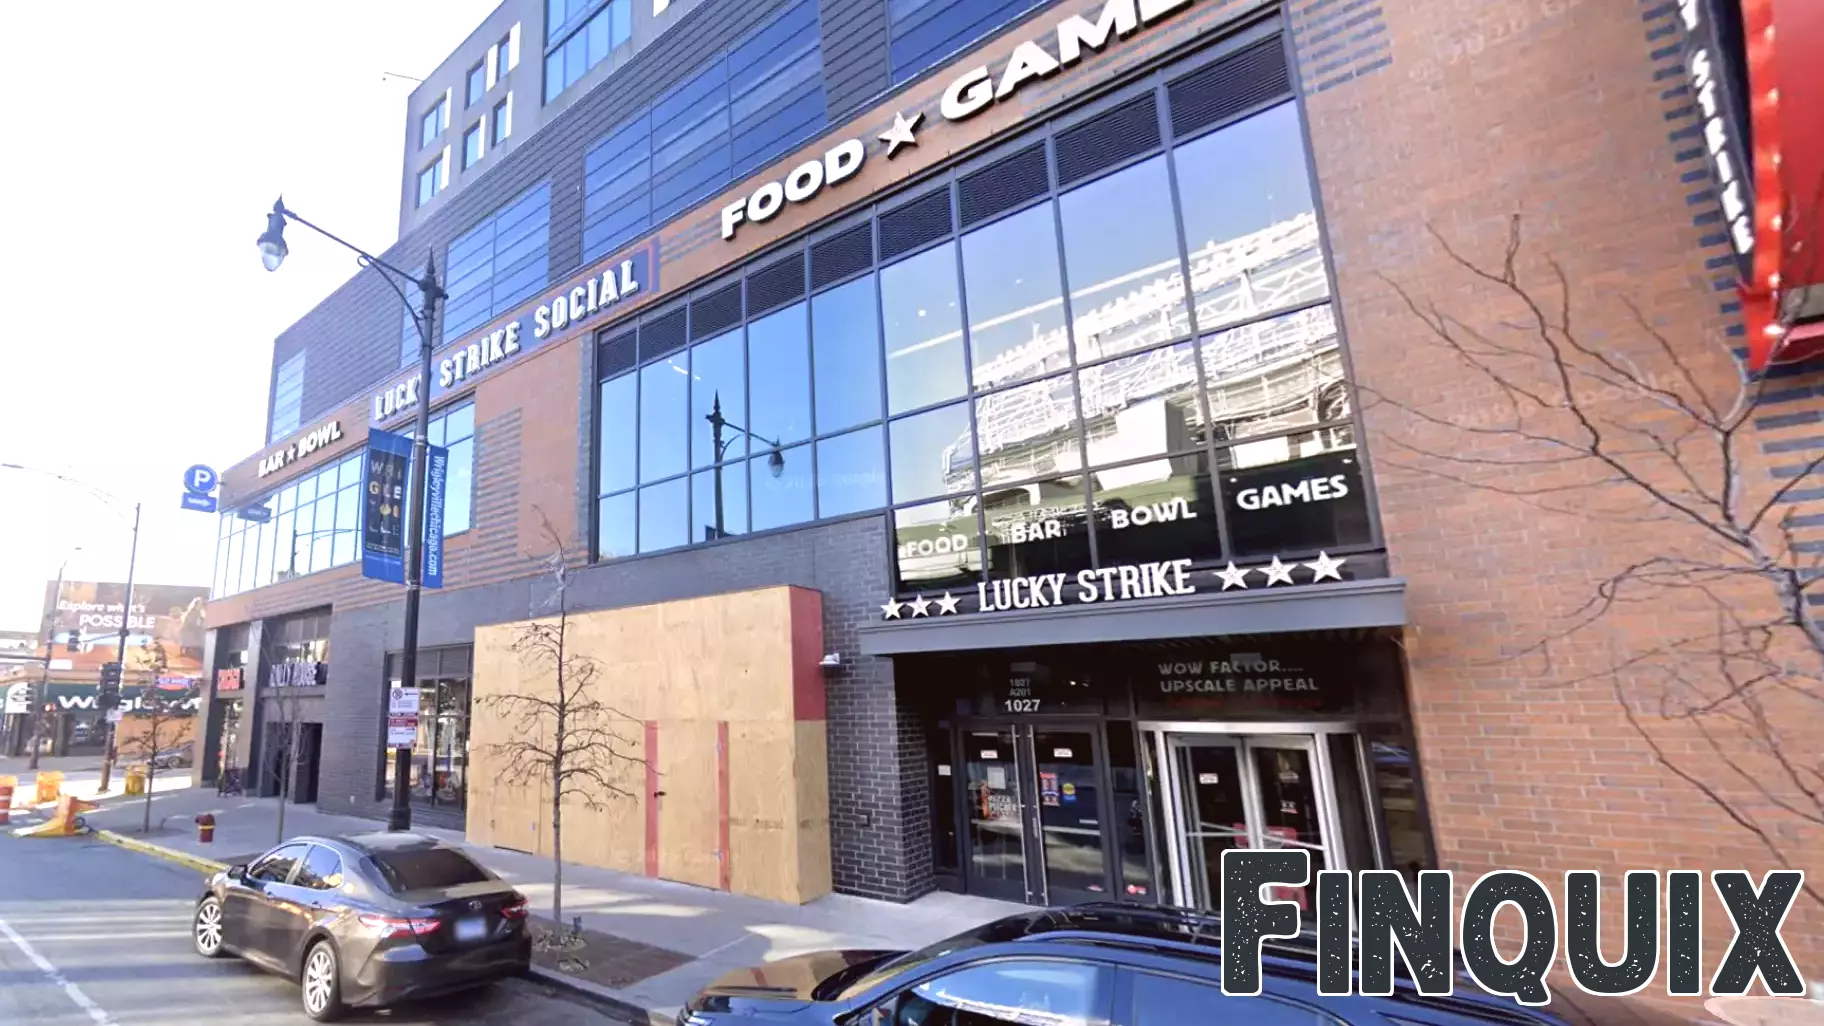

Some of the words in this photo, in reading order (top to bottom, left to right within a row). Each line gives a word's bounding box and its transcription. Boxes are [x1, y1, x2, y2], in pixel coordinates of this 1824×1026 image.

[1693, 49, 1754, 254] STRIKE
[720, 138, 865, 240] FOOD
[374, 371, 423, 421] LUCK
[439, 320, 522, 388] STRIKE
[534, 259, 639, 339] SOCIAL
[297, 420, 342, 458] BOWL
[193, 469, 211, 488] P
[905, 534, 969, 558] FOOD
[1010, 521, 1062, 546] BAR
[1111, 496, 1198, 530] BOWL
[1236, 474, 1350, 511] GAMES
[977, 572, 1067, 613] LUCKY
[1077, 558, 1196, 604] STRIKE
[80, 613, 155, 629] POSSBLE
[107, 603, 146, 613] wht's
[1158, 662, 1203, 676] WOW
[1160, 679, 1237, 693] UPSCALE
[1243, 677, 1319, 692] APPEAL
[1004, 699, 1041, 713] 1027
